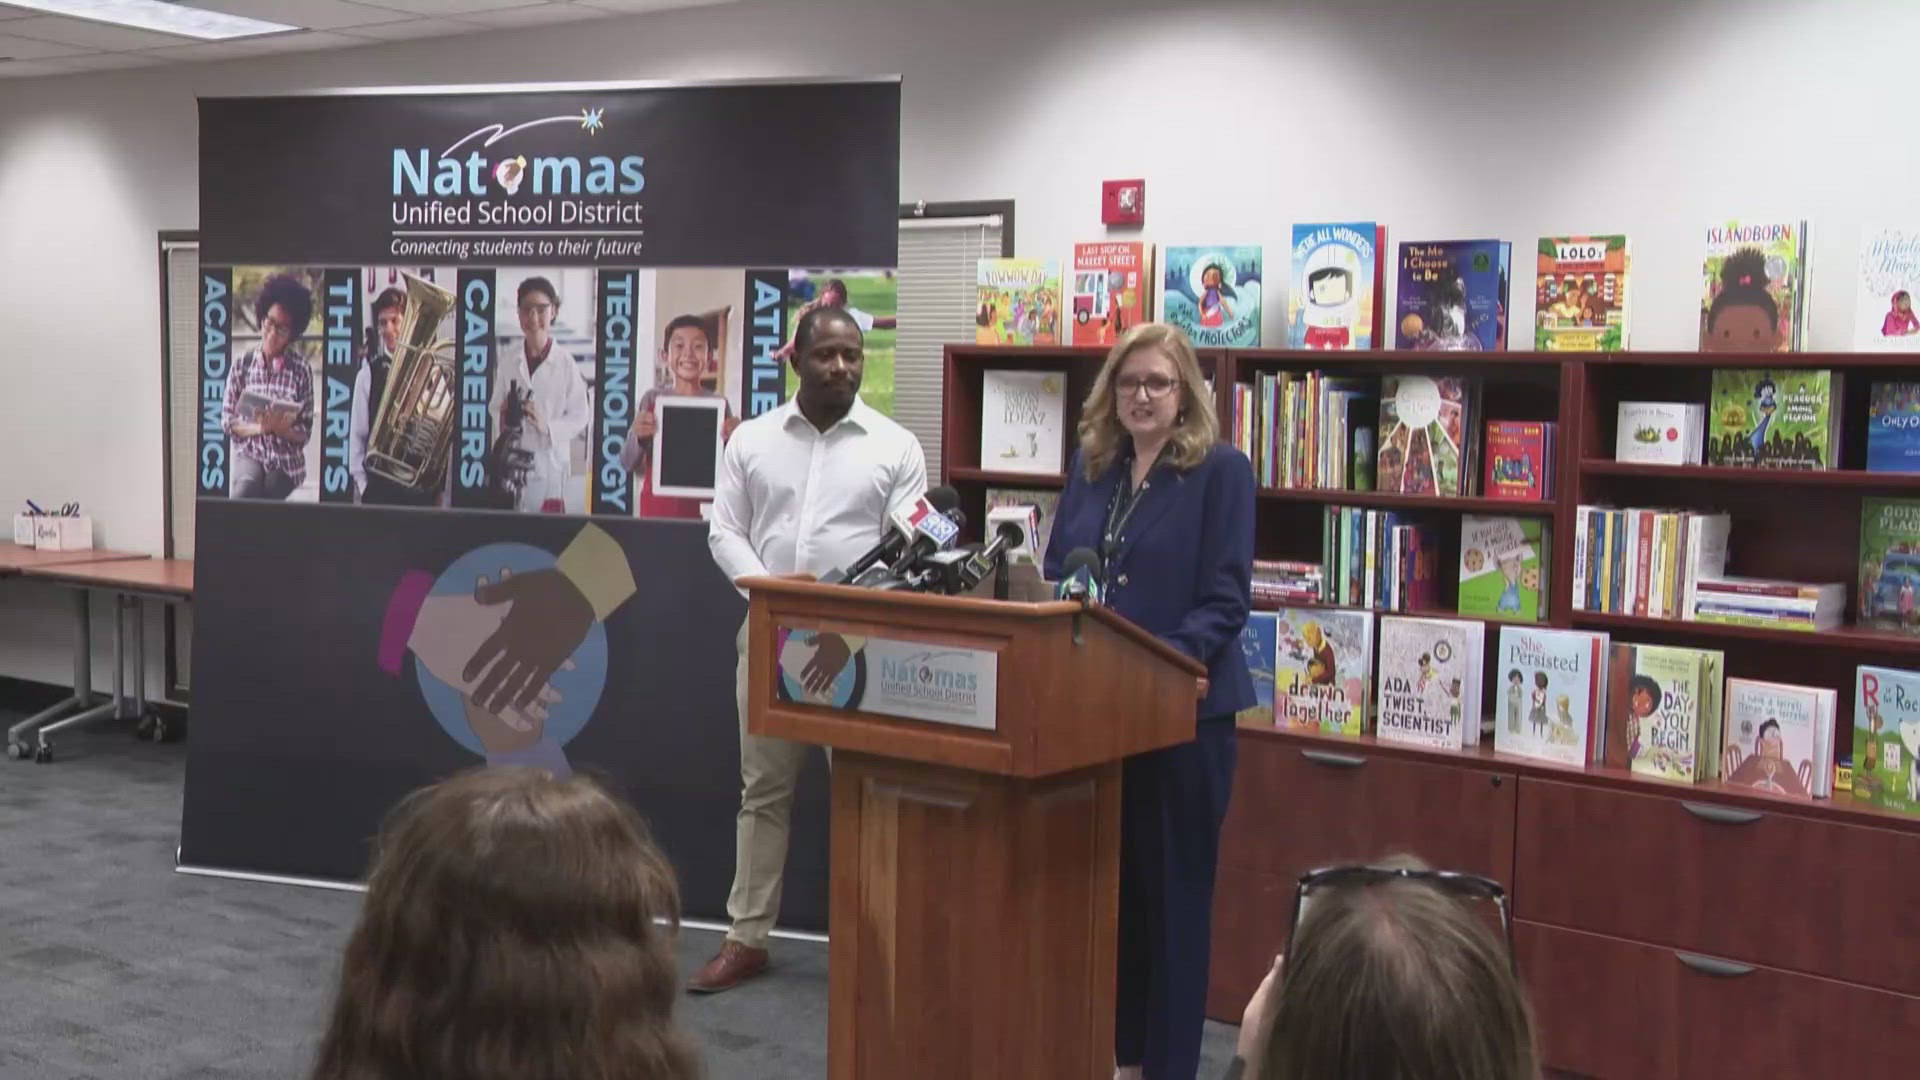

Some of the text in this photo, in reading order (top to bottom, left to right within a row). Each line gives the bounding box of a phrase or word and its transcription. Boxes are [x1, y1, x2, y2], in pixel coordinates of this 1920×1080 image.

[393, 148, 645, 196] Natomas
[392, 200, 643, 224] Unified School District
[1706, 223, 1791, 246] ISLANDBORN
[391, 238, 642, 260] Connecting students to their future
[1082, 244, 1099, 255] LAST
[1101, 244, 1117, 255] STOP
[1409, 246, 1425, 257] The
[1077, 255, 1137, 267] MARKET STREET
[201, 275, 227, 490] ACADEMICS
[324, 277, 353, 493] THE ARTS
[460, 279, 490, 488] CAREERS
[600, 273, 633, 512] TECHNOLOGY
[1519, 636, 1543, 653] She
[1509, 645, 1579, 673] Persisted
[881, 681, 912, 696] Unified
[945, 689, 977, 703] District
[1288, 673, 1345, 702] drawn
[1384, 676, 1411, 694] ADA
[1672, 679, 1690, 695] THE
[1862, 671, 1880, 708] R
[1663, 691, 1690, 714] DAY
[1382, 711, 1453, 736] SCIENTIST
[1660, 710, 1691, 732] YOU
[1650, 725, 1690, 753] BEGIN
